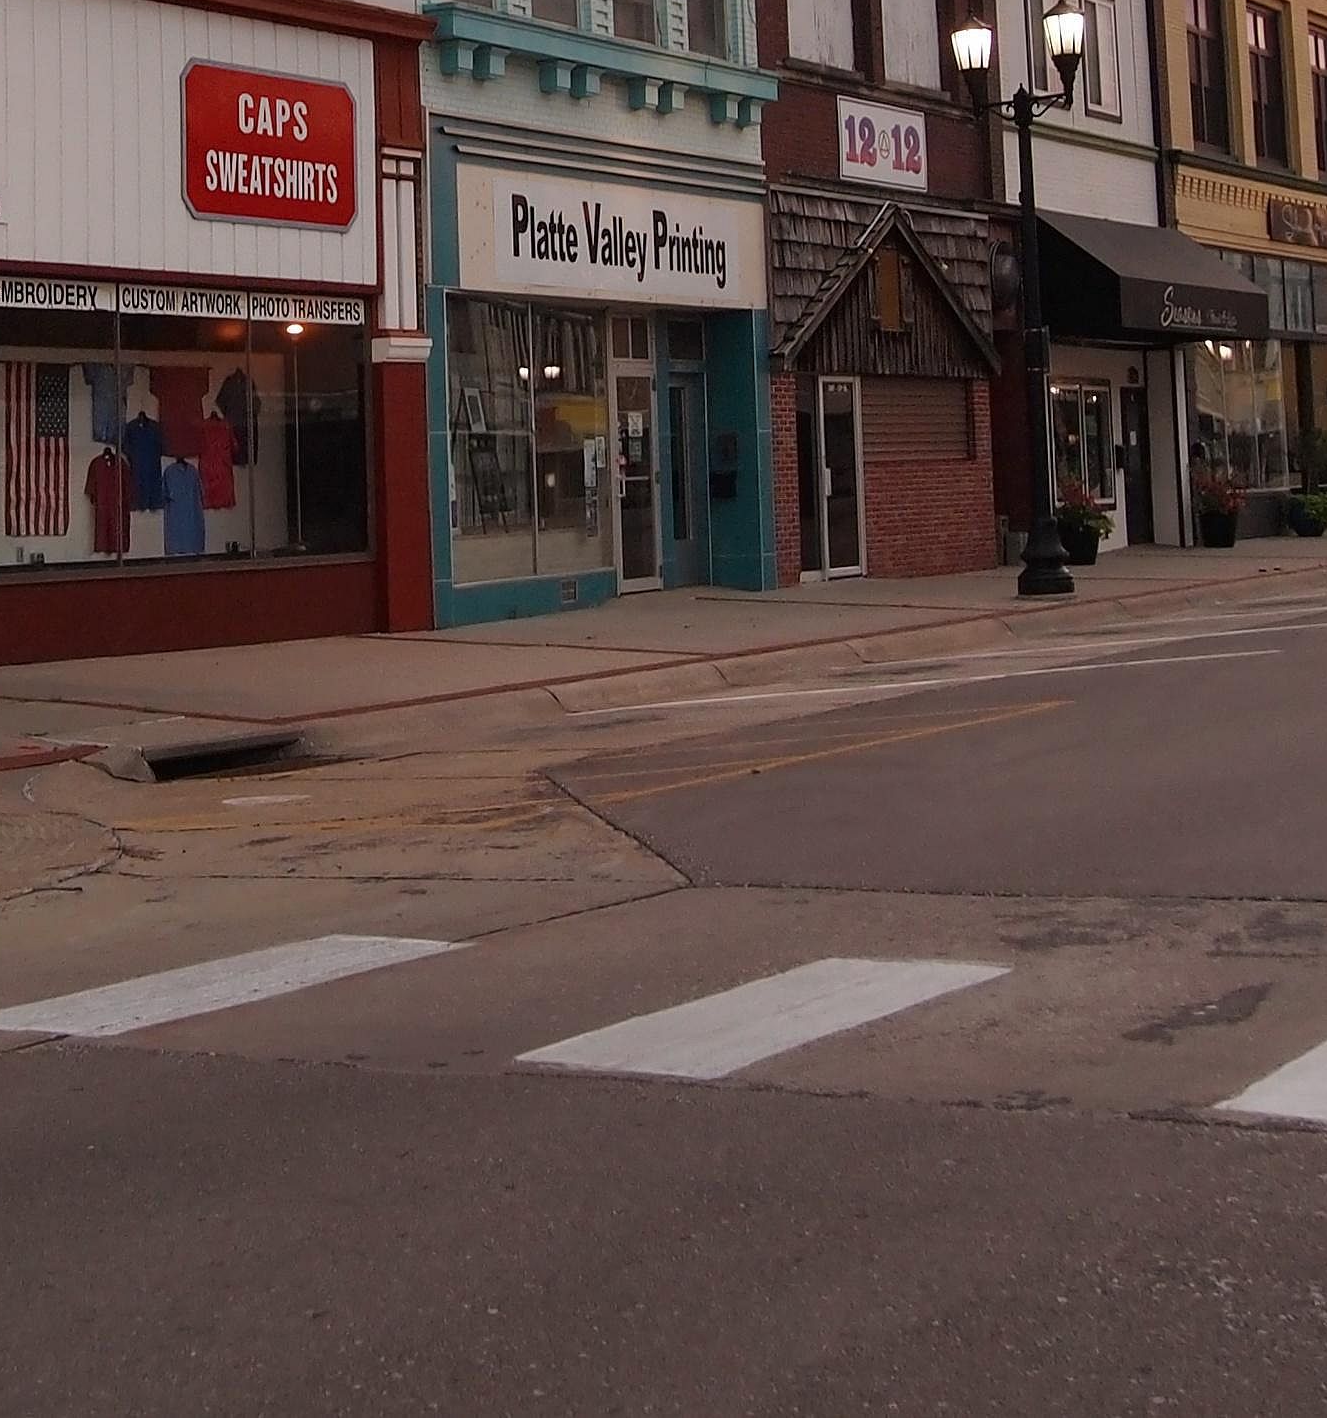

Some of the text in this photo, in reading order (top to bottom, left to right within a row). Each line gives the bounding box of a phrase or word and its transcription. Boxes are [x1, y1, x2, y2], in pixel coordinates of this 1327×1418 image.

[238, 92, 309, 142] CAPS
[844, 114, 922, 175] 12 12
[205, 150, 338, 205] SWEATSHIRTS
[511, 194, 727, 288] Platte Valley Printing
[121, 287, 242, 316] CUSTOM ARTWORK
[251, 296, 361, 322] PHOTO TRANSFERS
